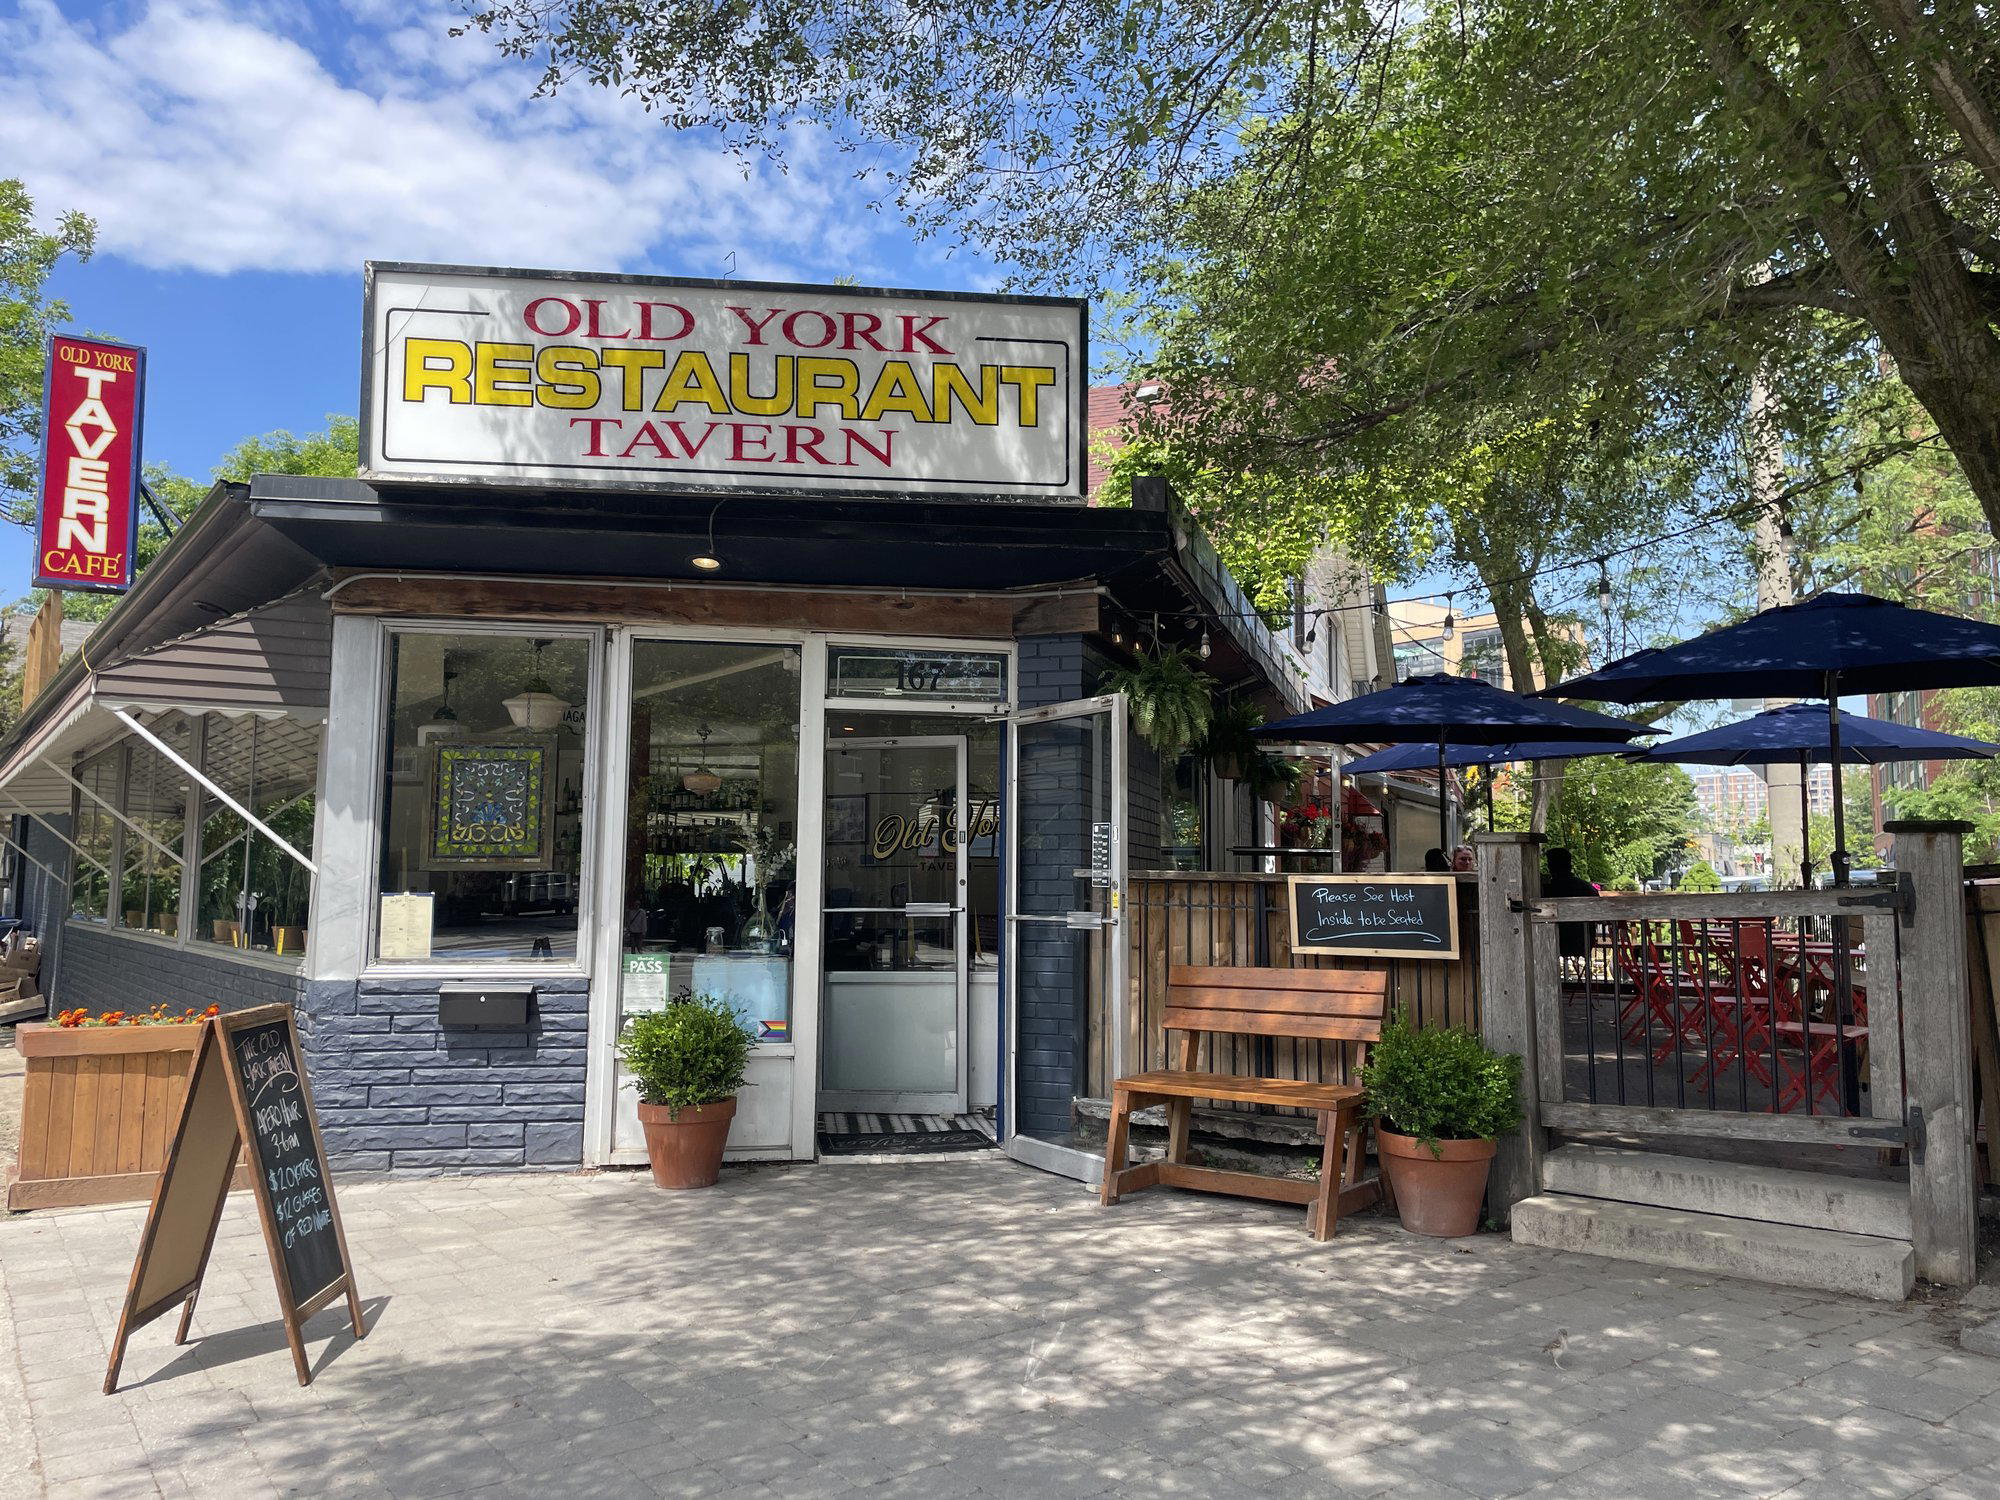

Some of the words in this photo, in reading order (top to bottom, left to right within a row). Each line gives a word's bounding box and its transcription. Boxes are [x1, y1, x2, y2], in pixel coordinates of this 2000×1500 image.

[524, 297, 695, 341] OLD
[725, 306, 956, 355] YORK
[60, 346, 90, 364] OLD
[94, 351, 134, 372] YORK
[403, 336, 1056, 428] RESTAURANT
[570, 418, 900, 468] TAVERN
[57, 366, 118, 554] TAVERN
[44, 550, 121, 579] CAFÉ
[896, 660, 948, 691] 167
[872, 813, 939, 859] Old
[1312, 888, 1356, 903] Please
[1364, 886, 1384, 902] See
[1390, 888, 1415, 901] Host
[1317, 909, 1354, 926] Inside
[1388, 909, 1424, 925] Seated
[630, 960, 663, 973] PASS
